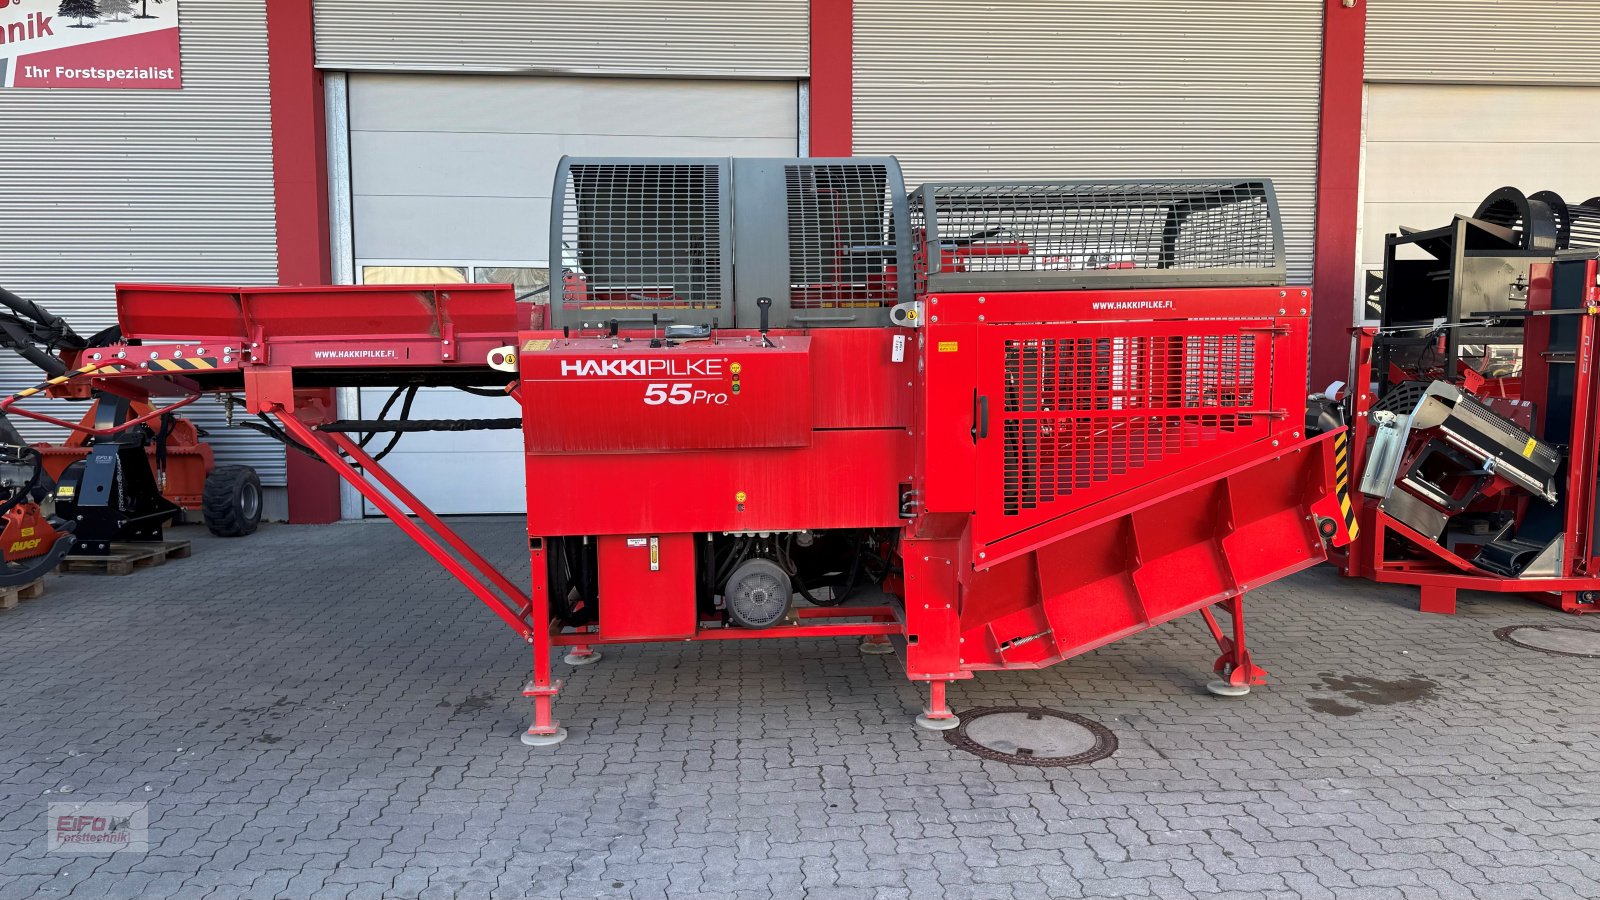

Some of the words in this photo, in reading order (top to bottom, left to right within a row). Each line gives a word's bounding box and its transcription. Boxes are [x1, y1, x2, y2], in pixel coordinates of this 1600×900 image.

[24, 66, 50, 78] Ihr
[55, 66, 174, 82] Forstspezialist
[1092, 301, 1173, 310] WWW.HAKKIPILKE.FI
[314, 350, 395, 359] WWW.HAKKIPILKE.FI
